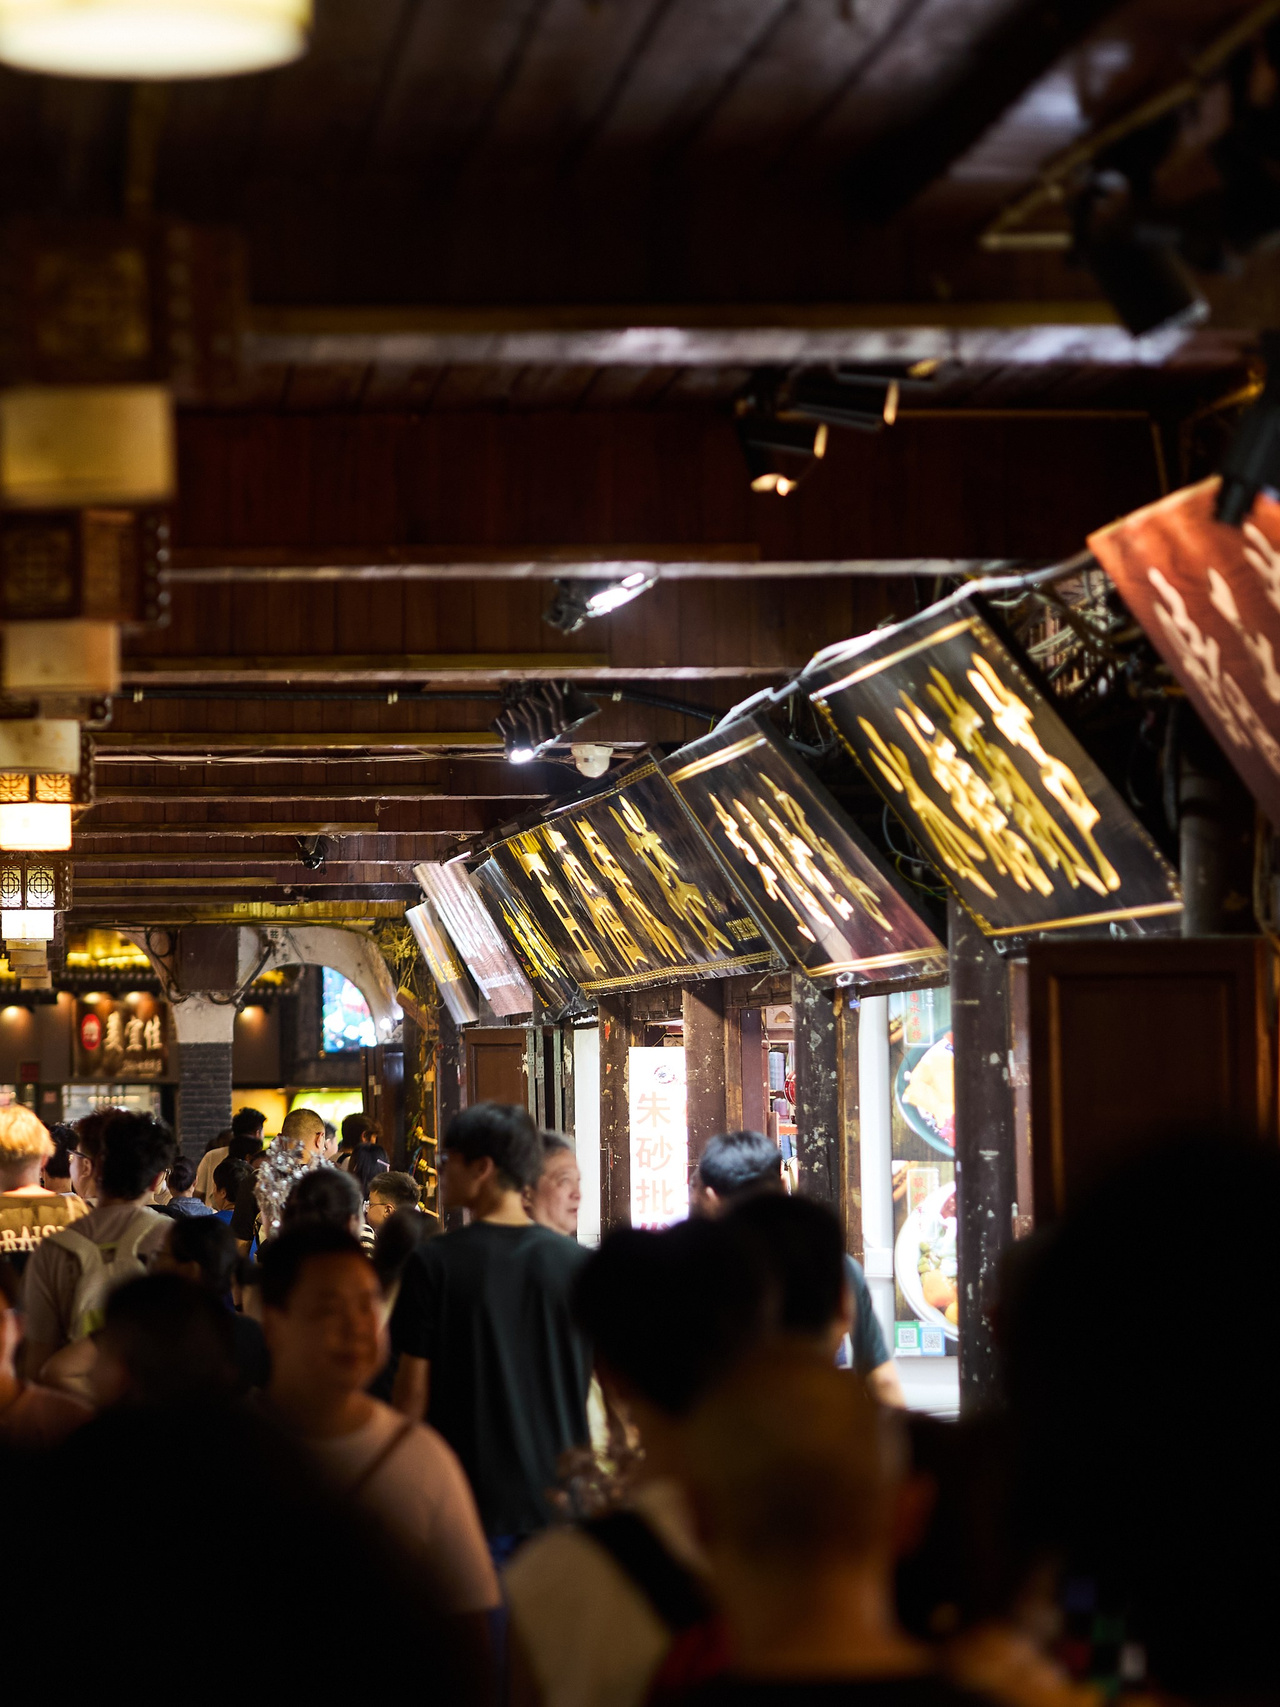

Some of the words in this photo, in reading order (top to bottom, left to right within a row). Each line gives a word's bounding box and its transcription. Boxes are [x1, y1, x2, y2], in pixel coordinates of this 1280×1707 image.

[856, 652, 1122, 899] 冰糖葫芦
[516, 795, 735, 974] 百福银楼
[636, 1091, 674, 1230] 朱砂批
